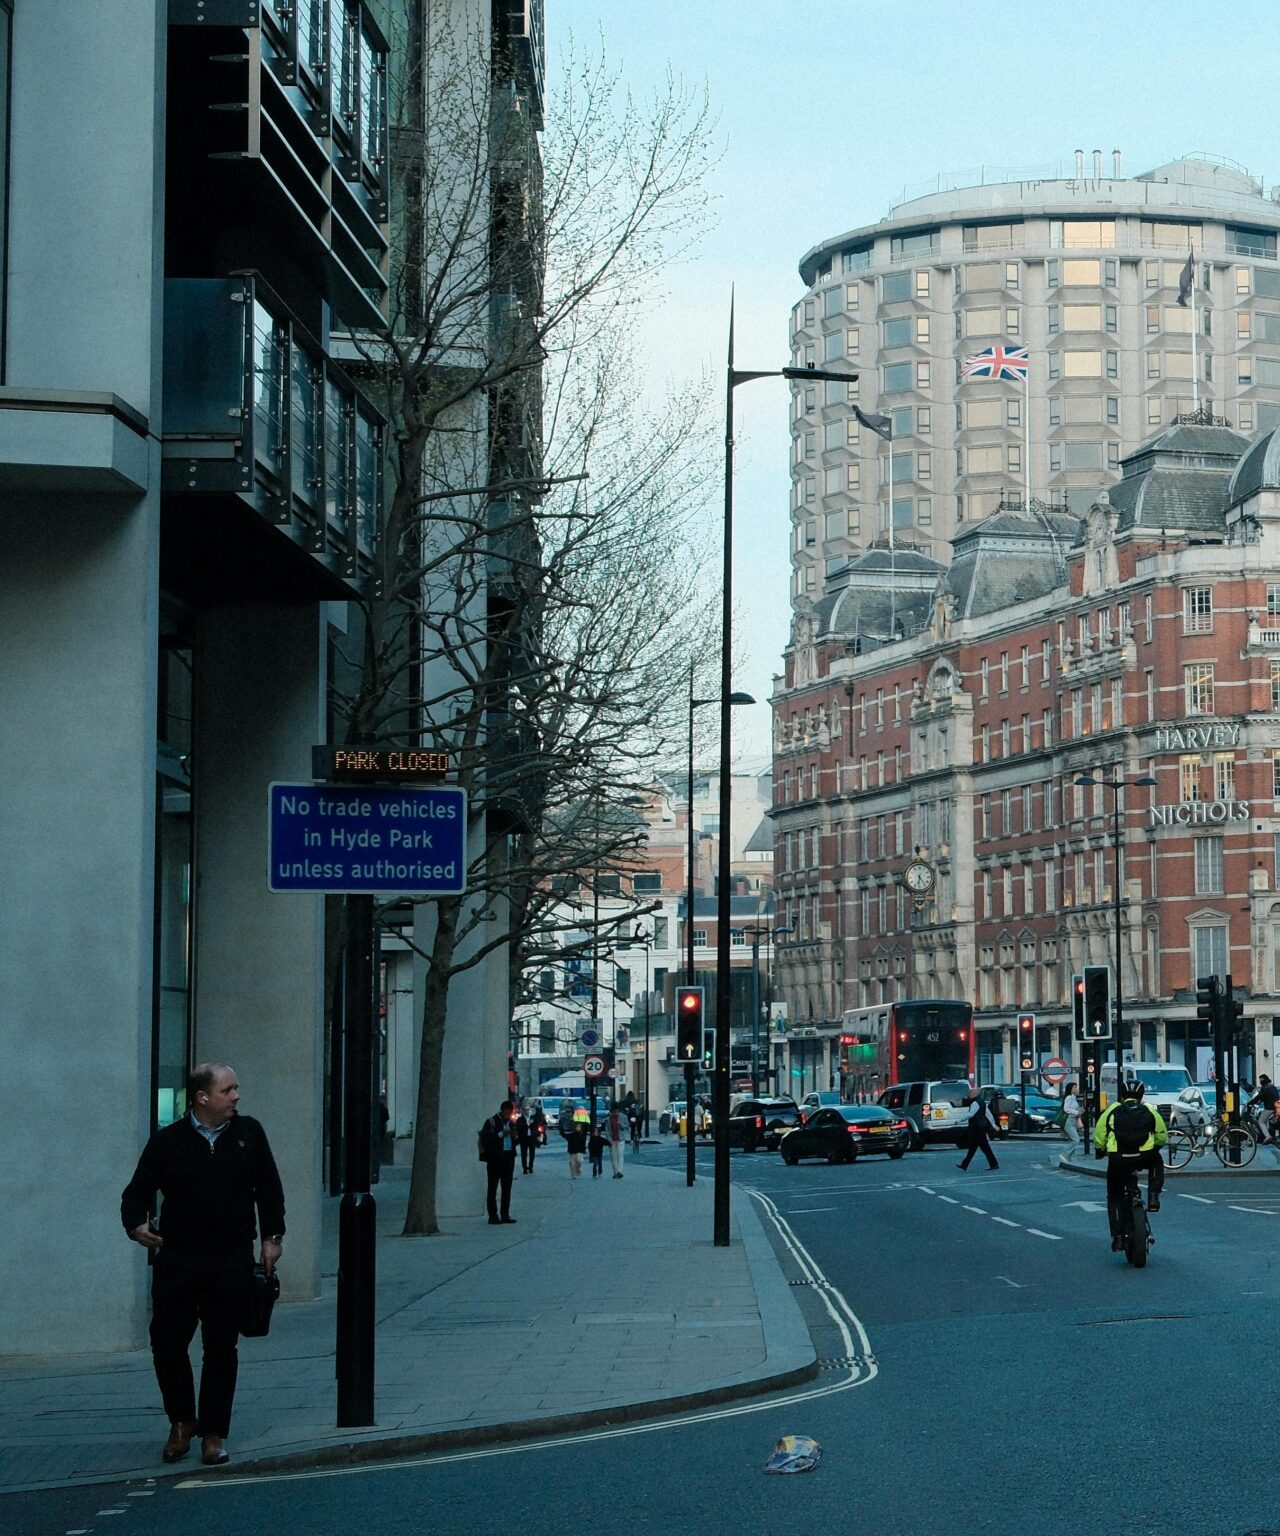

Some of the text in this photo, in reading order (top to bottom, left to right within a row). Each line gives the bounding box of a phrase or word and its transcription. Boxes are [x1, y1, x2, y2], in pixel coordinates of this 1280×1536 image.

[1156, 724, 1240, 750] HARVEY
[335, 751, 449, 771] PARK CLOSED
[280, 796, 457, 819] No trade vehicles
[1150, 800, 1250, 826] NICHOLS
[304, 828, 433, 851] in Hyde Park
[279, 859, 456, 879] unless authorised
[927, 1031, 940, 1042] 452
[586, 1061, 602, 1071] 20
